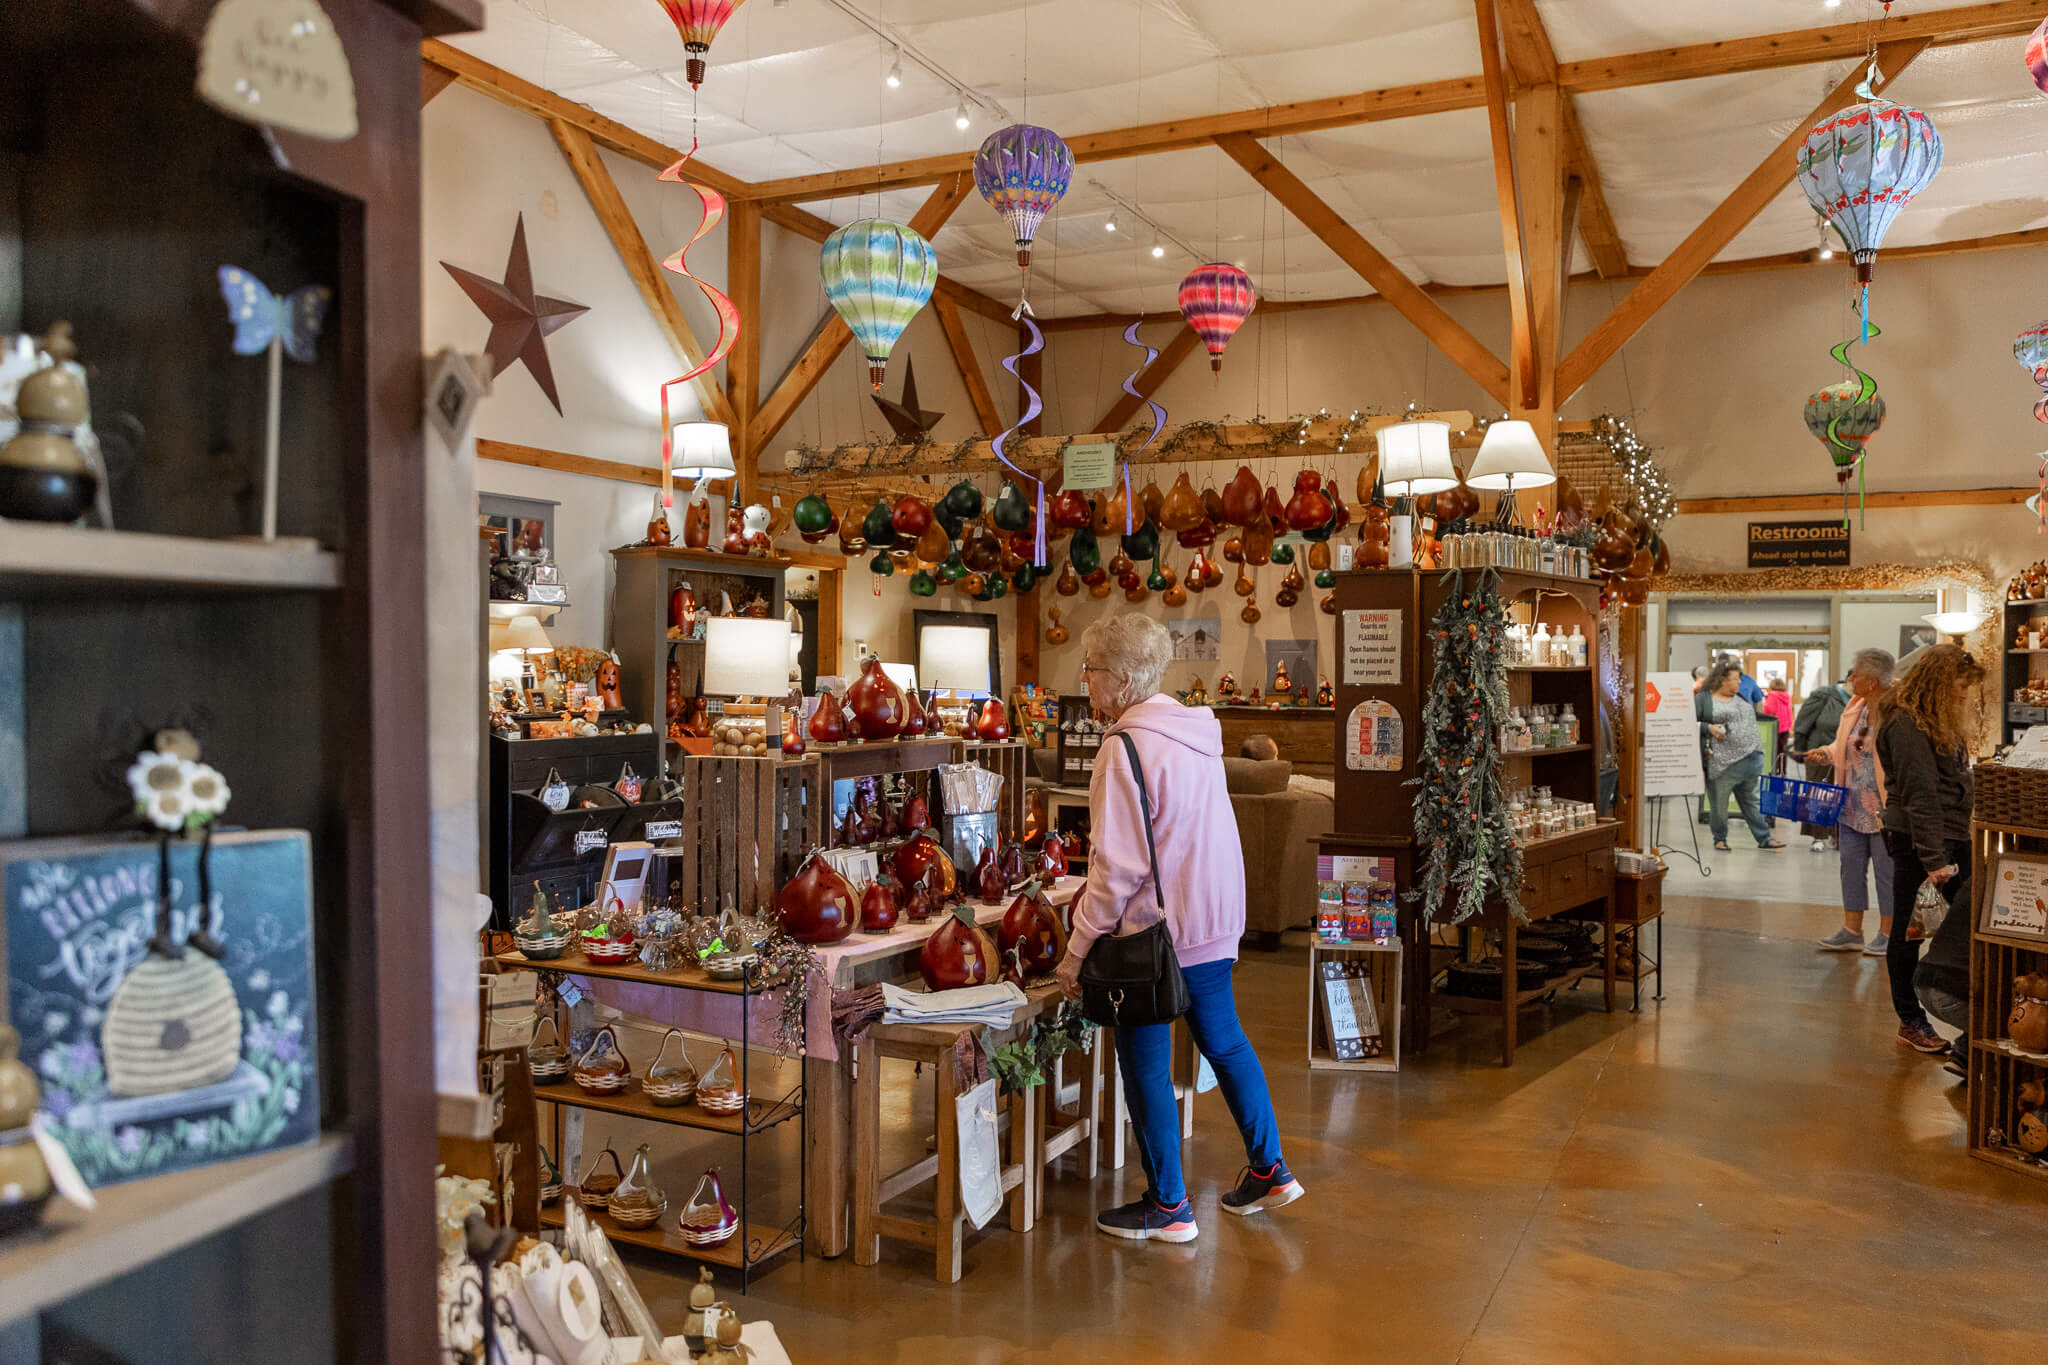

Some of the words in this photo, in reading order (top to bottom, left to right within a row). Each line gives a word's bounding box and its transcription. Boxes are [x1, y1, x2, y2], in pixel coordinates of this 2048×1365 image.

[1751, 526, 1848, 539] Restrooms
[1828, 550, 1846, 558] Left
[1360, 614, 1389, 622] WARNING
[1367, 657, 1382, 665] placed
